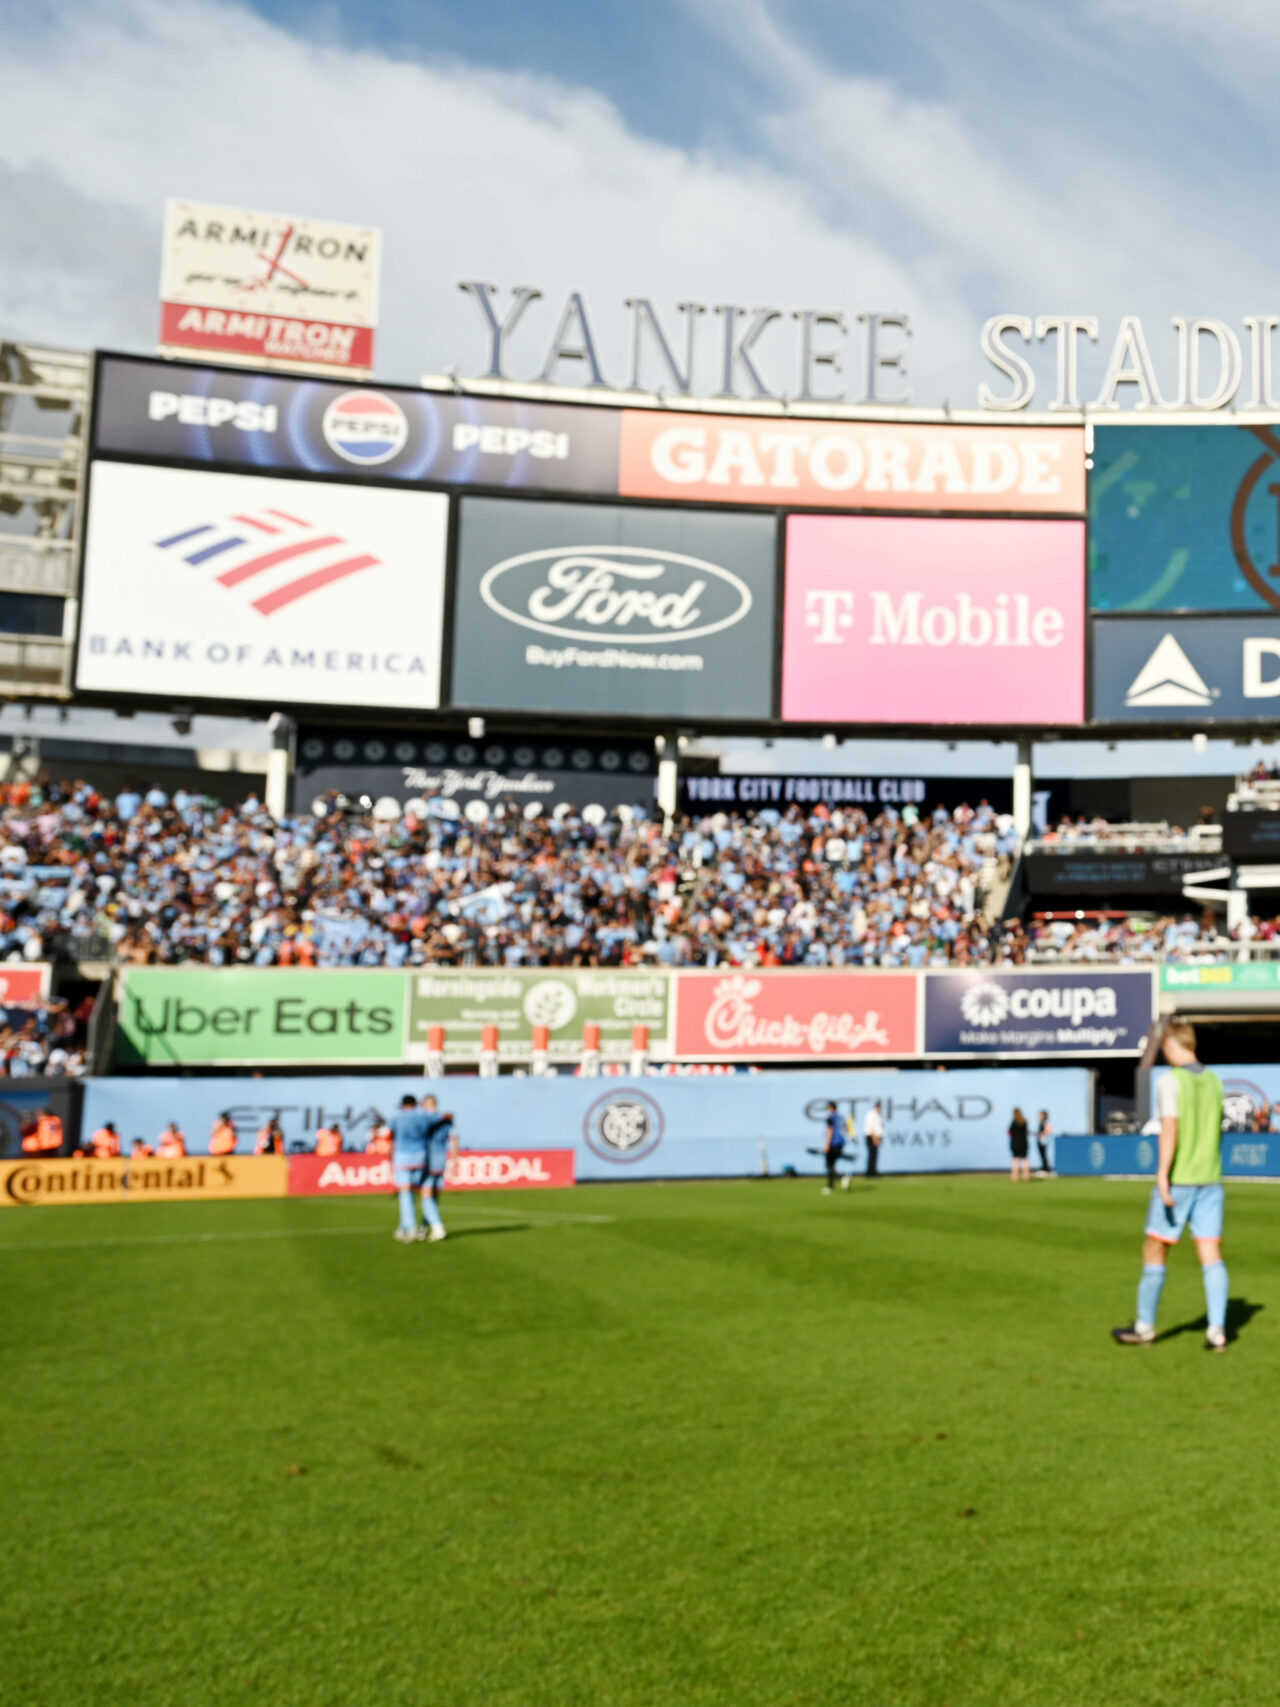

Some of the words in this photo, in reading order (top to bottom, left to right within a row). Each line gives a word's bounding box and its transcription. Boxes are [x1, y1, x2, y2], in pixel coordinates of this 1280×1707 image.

[177, 308, 358, 349] ARMITRON
[457, 280, 913, 404] YANKEE
[149, 391, 279, 433] PEPSI
[331, 416, 402, 437] PEPSI
[453, 424, 570, 460] PEPSI
[651, 427, 1061, 495] GATORADE
[528, 556, 707, 629] Ford
[868, 590, 1065, 648] Mobile
[90, 635, 192, 662] BANK
[205, 642, 252, 665] OF
[263, 646, 427, 675] AMERICA
[525, 645, 704, 671] BuyFordNow.com
[687, 776, 737, 801] YORK
[739, 777, 782, 801] CITY
[785, 778, 876, 801] FOOTBALL
[879, 779, 927, 802] CLUB
[1166, 965, 1234, 985] bet365
[133, 997, 262, 1035] Uber
[274, 997, 394, 1035] Eats
[1011, 987, 1117, 1026] coupa
[221, 1104, 388, 1132] ETIHA
[804, 1094, 993, 1122] ETHAD
[318, 1159, 396, 1187] Aud
[1229, 1144, 1268, 1168] AT&T
[5, 1163, 206, 1204] Continental
